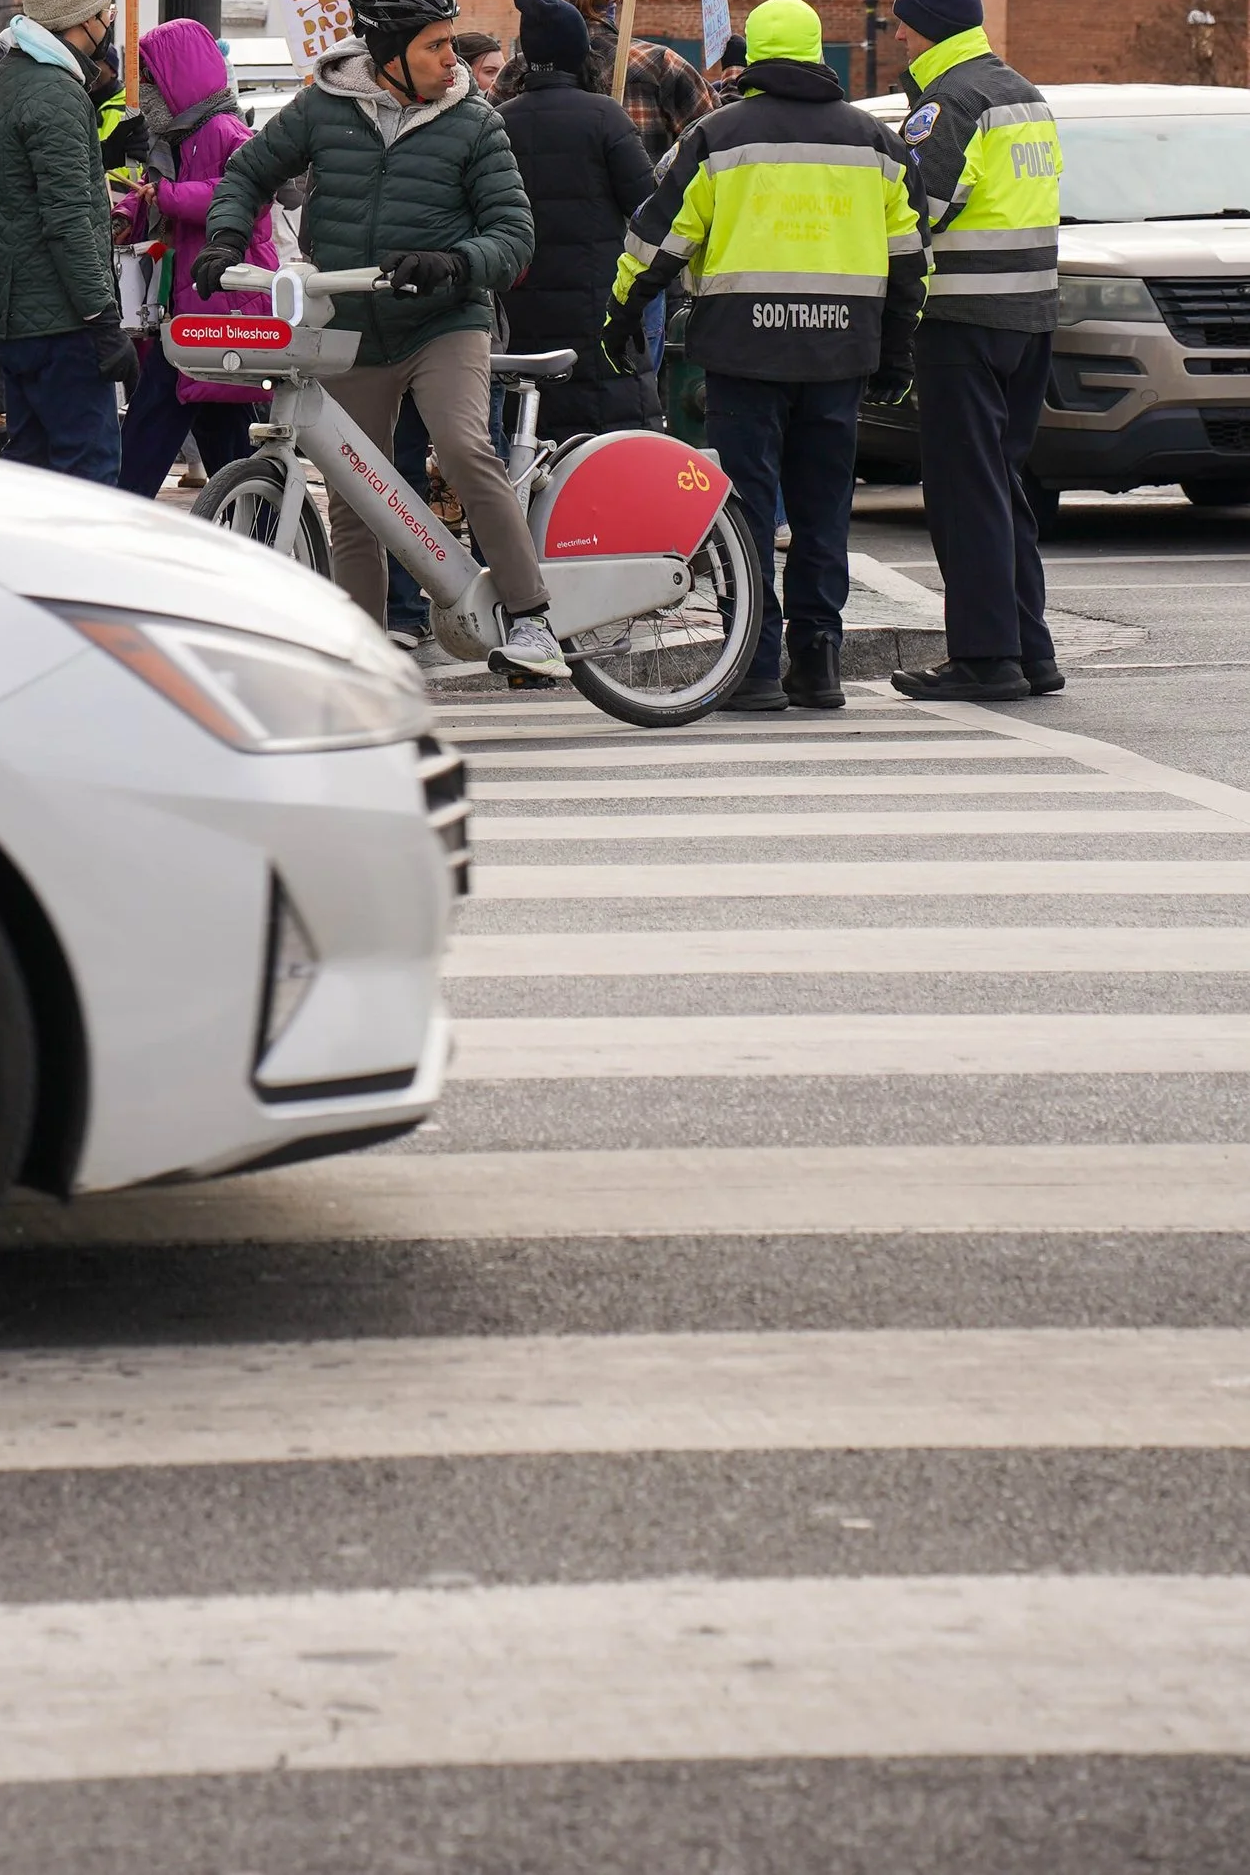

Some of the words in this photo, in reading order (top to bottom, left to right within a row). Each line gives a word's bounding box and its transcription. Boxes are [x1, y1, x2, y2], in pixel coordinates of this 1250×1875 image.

[303, 9, 353, 35] DRO
[303, 27, 352, 57] ELB
[752, 303, 849, 330] SOD/TRAFFIC
[182, 326, 223, 340] capital
[226, 325, 280, 340] bikeshare
[341, 443, 389, 495] capital
[387, 489, 446, 562] bikeshare
[556, 537, 591, 549] electrified
